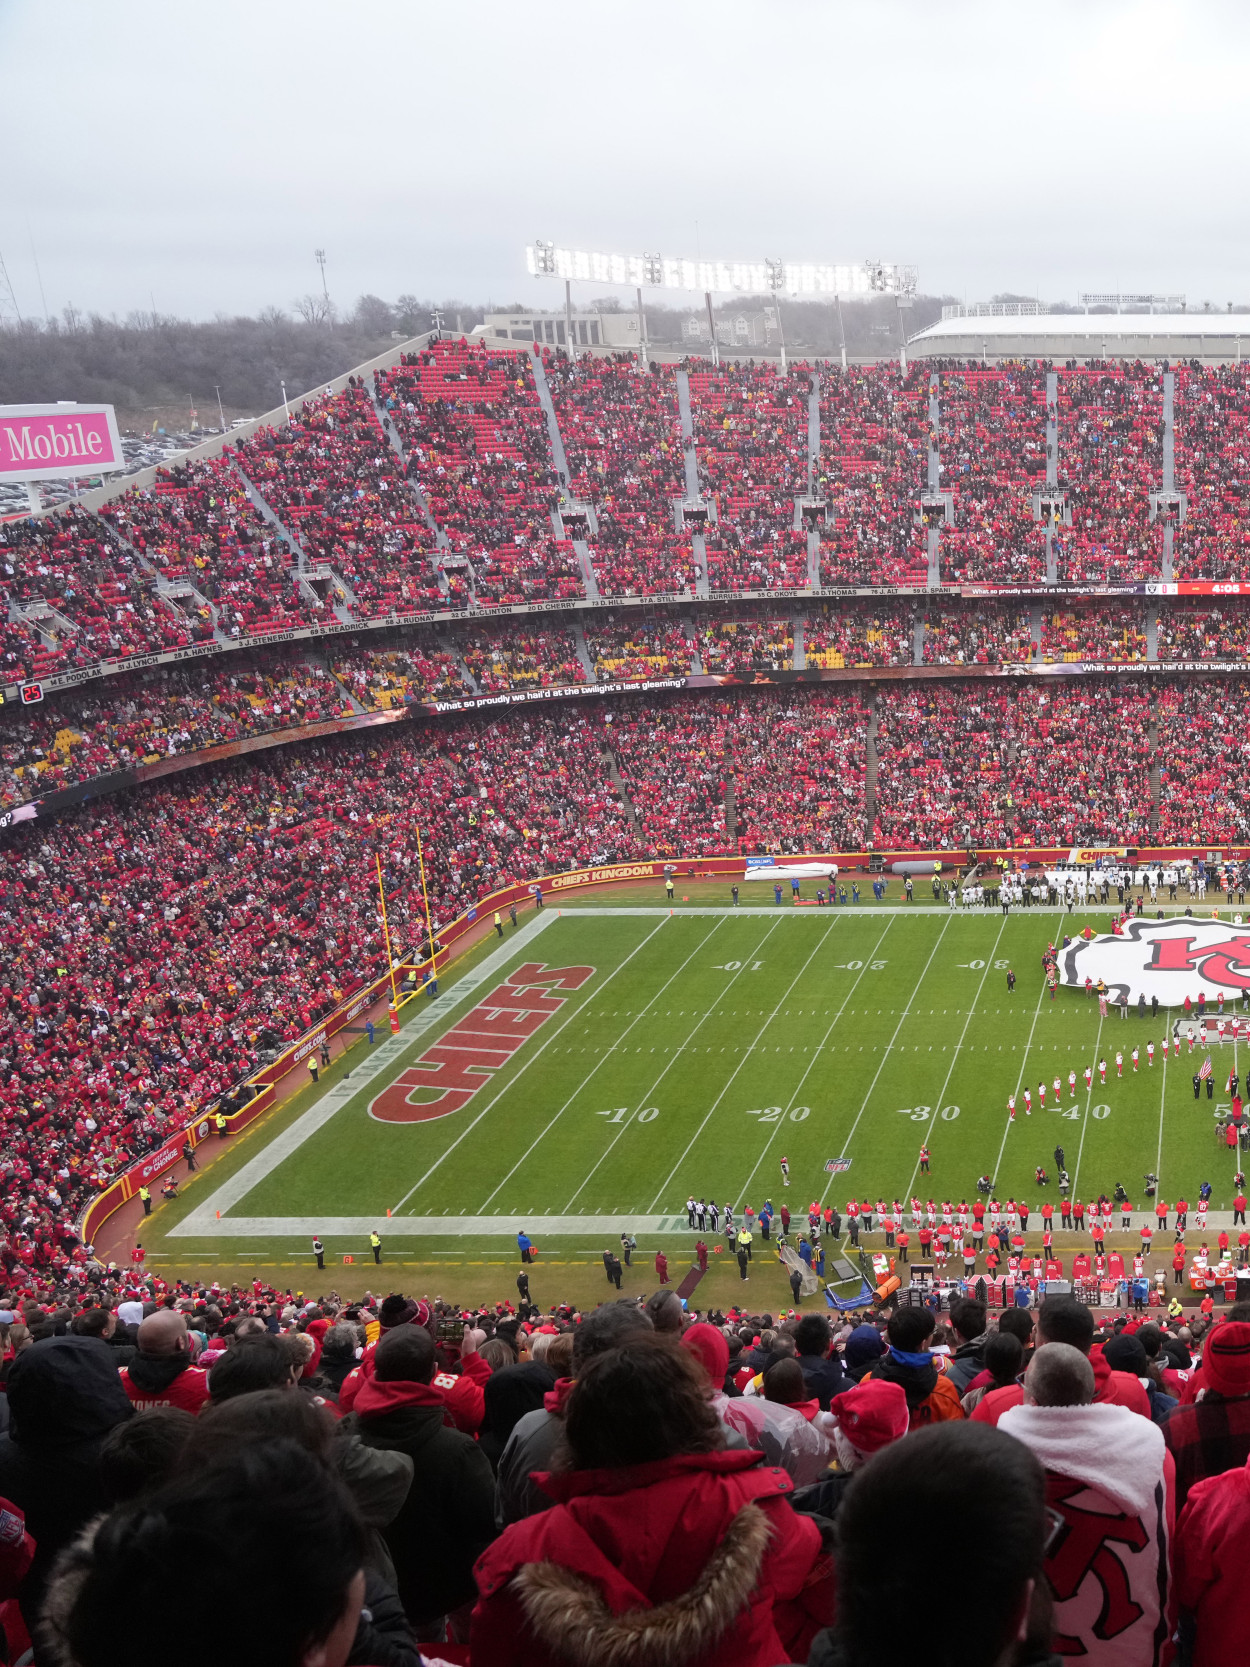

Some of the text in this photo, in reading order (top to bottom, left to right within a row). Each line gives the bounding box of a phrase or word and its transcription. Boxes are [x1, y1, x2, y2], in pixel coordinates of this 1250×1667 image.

[4, 423, 102, 461] Mobile
[1212, 585, 1240, 593] 4:05
[403, 615, 435, 624] RUDNAY
[329, 622, 369, 634] HEADRICK
[252, 633, 294, 645] STENERUD
[192, 645, 222, 656] HAYNES
[132, 657, 158, 668] LYNCH
[1118, 664, 1148, 673] proudly
[1162, 663, 1183, 671] hail'd
[1210, 663, 1246, 672] twilight's
[66, 669, 102, 683] PODOLAK
[24, 686, 41, 701] 25
[436, 701, 462, 712] What
[476, 695, 510, 710] proudly
[527, 690, 550, 700] hail'd
[564, 687, 579, 696] the
[581, 684, 621, 697] twilight's
[623, 681, 640, 691] last
[642, 678, 686, 693] gleaming?
[552, 866, 653, 888] CHIEFS KINGDOM
[723, 960, 767, 971] 10
[846, 960, 889, 970] 20
[969, 959, 1010, 969] 30
[330, 1084, 358, 1097] IT
[350, 1039, 410, 1078] TAKES
[405, 1014, 440, 1034] ALL
[451, 980, 478, 992] US
[367, 962, 597, 1124] CHIEFS
[605, 1107, 660, 1123] 10
[757, 1106, 811, 1122] 20
[910, 1105, 961, 1121] 30
[1060, 1104, 1111, 1120] 40
